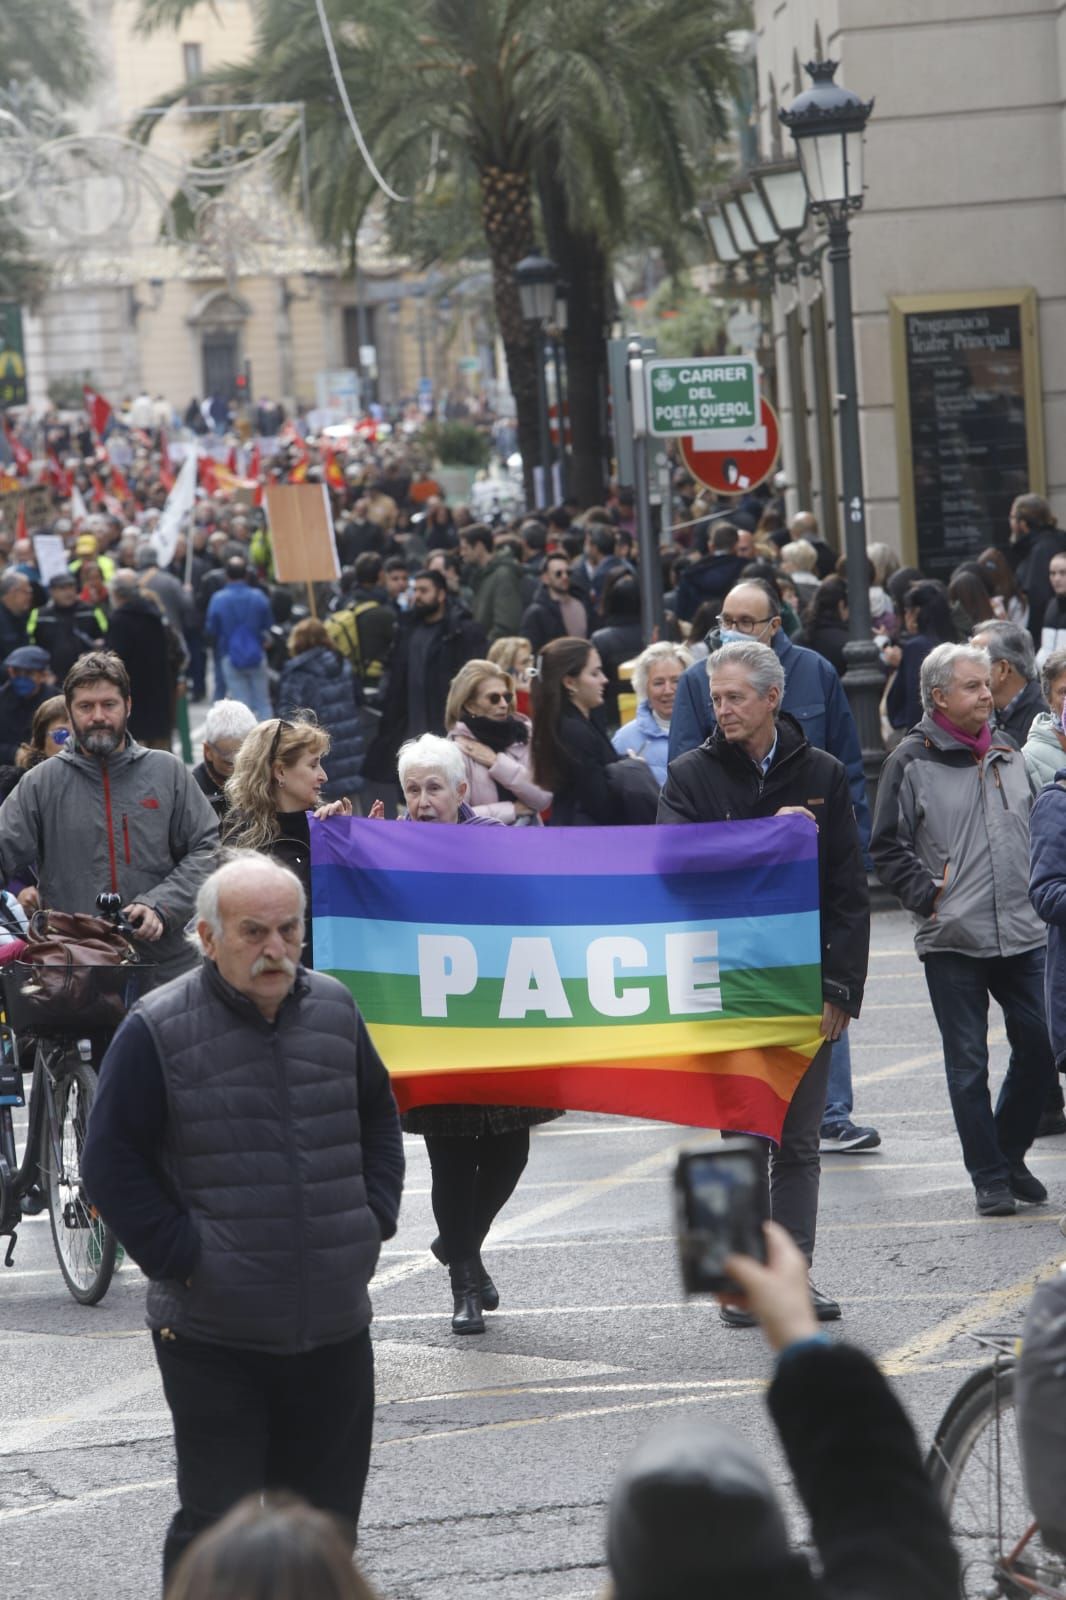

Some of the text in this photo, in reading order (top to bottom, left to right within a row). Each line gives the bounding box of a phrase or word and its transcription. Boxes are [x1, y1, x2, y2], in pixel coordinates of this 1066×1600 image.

[953, 328, 1010, 352] Principal
[679, 367, 747, 383] CARRER
[688, 387, 716, 400] DEL
[655, 402, 751, 420] POETA QUEROL
[418, 931, 723, 1018] PACE
